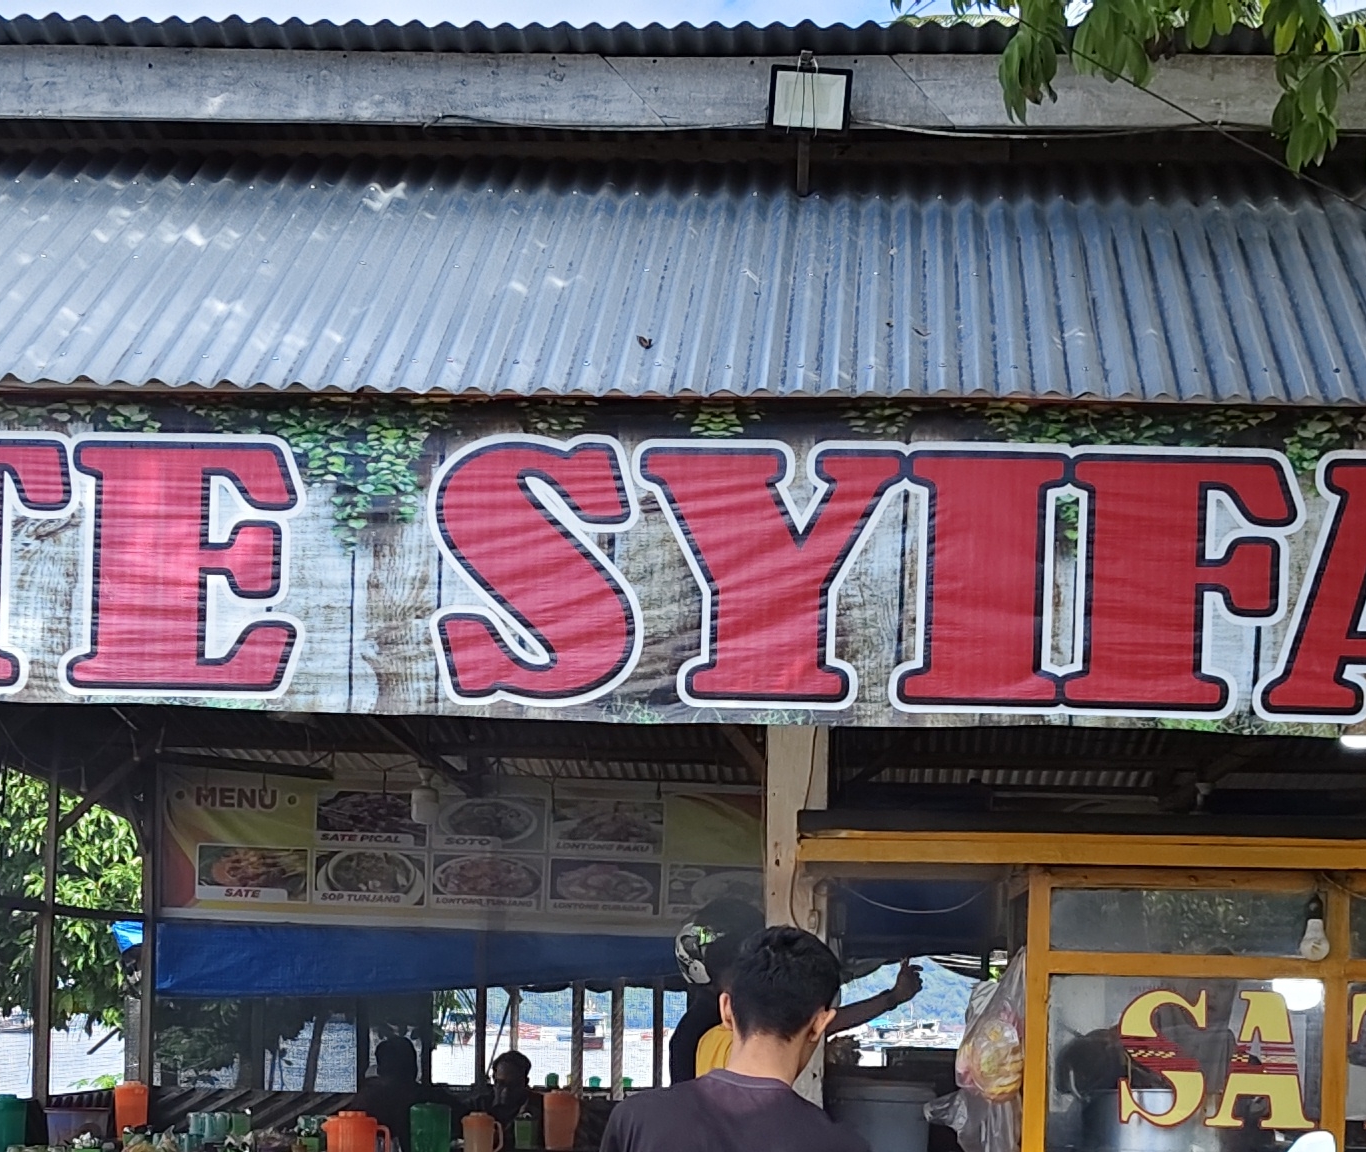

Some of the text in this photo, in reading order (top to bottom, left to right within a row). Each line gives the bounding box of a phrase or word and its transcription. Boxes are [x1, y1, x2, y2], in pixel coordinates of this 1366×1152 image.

[195, 786, 277, 810] MENU
[320, 832, 401, 844] SATE PICAL
[444, 837, 492, 846] SOTO
[224, 888, 261, 898] SATE
[320, 892, 345, 901] SOP
